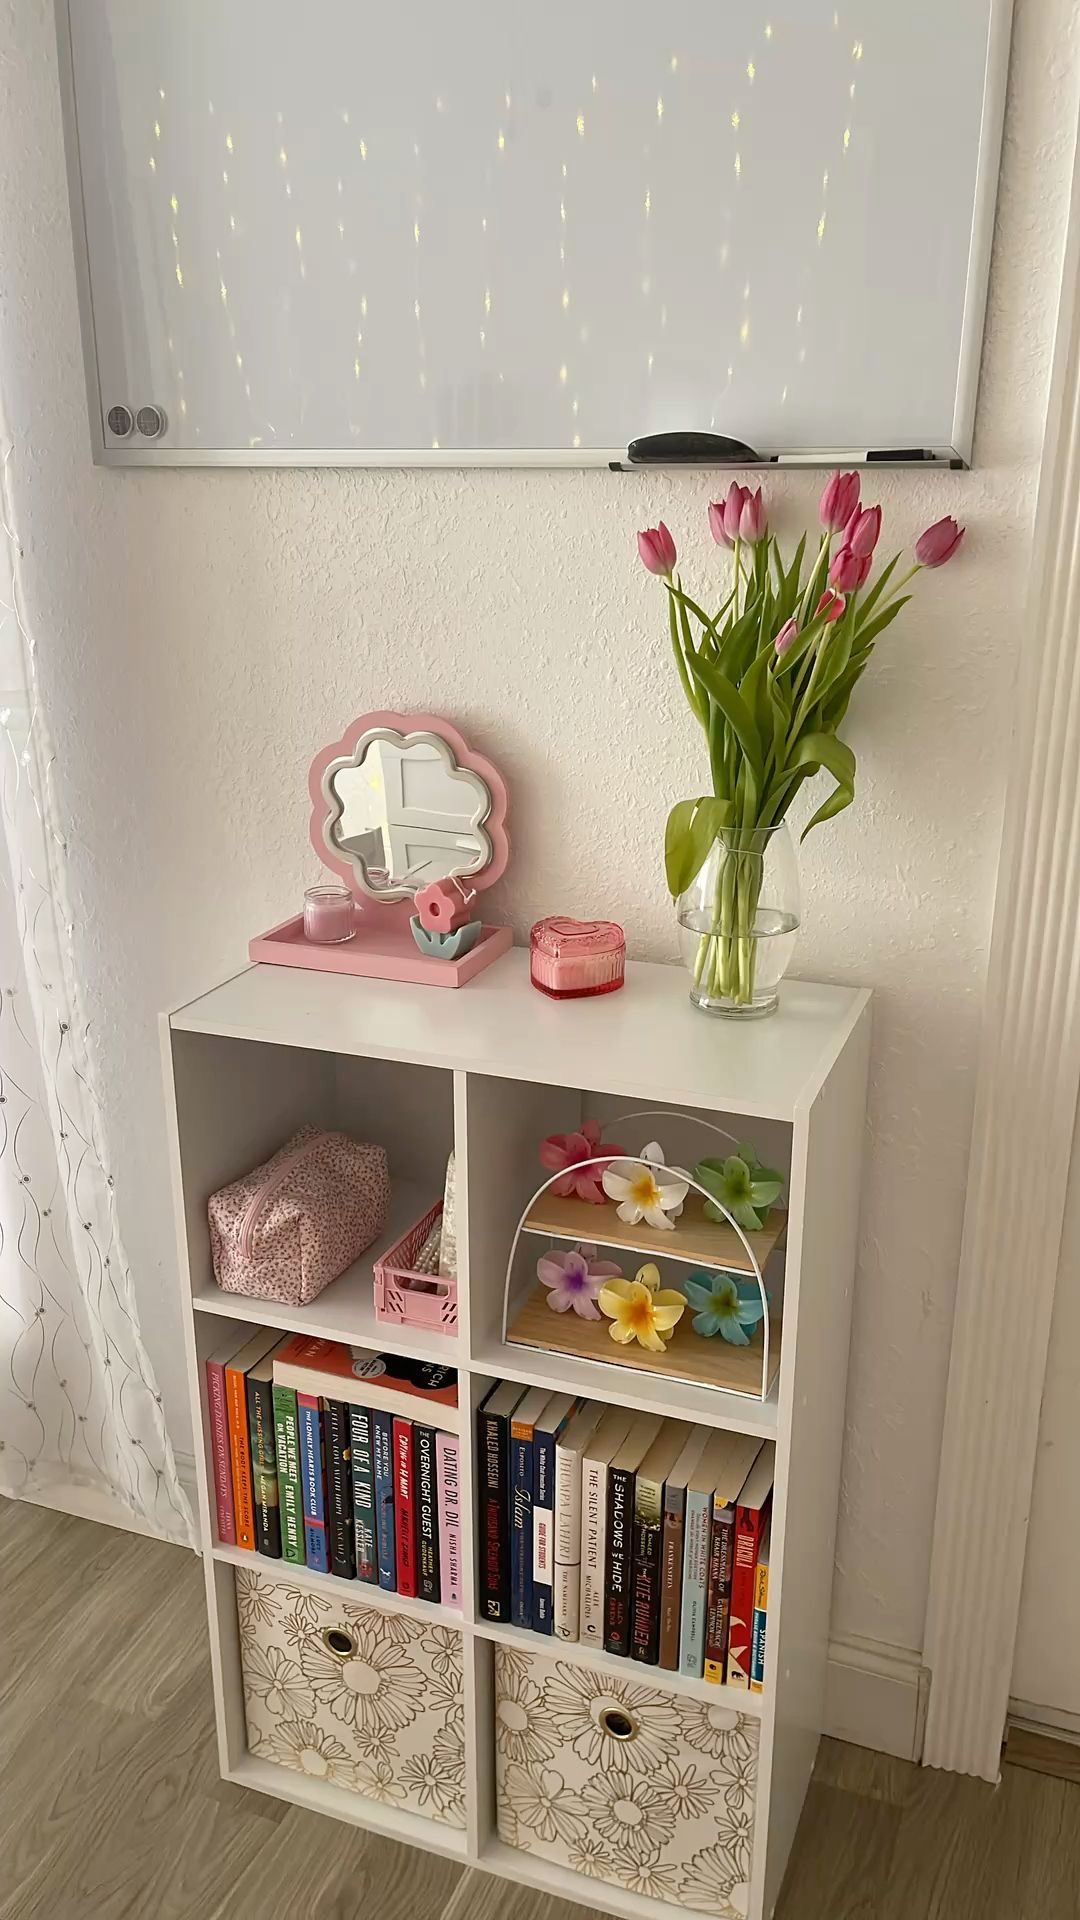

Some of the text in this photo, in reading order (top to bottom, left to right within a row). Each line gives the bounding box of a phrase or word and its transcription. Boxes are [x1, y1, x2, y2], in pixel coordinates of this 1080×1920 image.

[211, 1372, 221, 1409] PICKING
[217, 1445, 224, 1459] ON
[256, 1421, 264, 1449] MISSING
[286, 1415, 297, 1483] PEOPLE WE MEET
[278, 1434, 288, 1474] VACATION
[307, 1450, 315, 1478] HEARTS
[351, 1413, 371, 1508] FOUR OF A KIND
[376, 1447, 382, 1459] MY
[487, 1420, 498, 1489] KHALED HOSSEINI
[219, 1460, 228, 1498] SUNDAYS
[399, 1468, 408, 1478] H
[400, 1478, 408, 1500] MART
[420, 1439, 432, 1540] OVERNIGHT GUEST
[443, 1447, 459, 1527] DATING DR. DIL
[613, 1474, 627, 1482] THE
[285, 1485, 297, 1548] EMILY HENRY
[514, 1484, 531, 1529] Islam
[559, 1455, 572, 1559] JHUMPA LAHIRI
[587, 1470, 598, 1568] THE SILENT PATIENT
[613, 1483, 624, 1548] SHADOWS
[701, 1507, 709, 1529] WOMEN
[355, 1518, 365, 1553] KESSLER
[364, 1527, 373, 1548] KATE
[538, 1522, 546, 1569] GUIDE FOR STUDENTS
[701, 1530, 707, 1538] IN
[736, 1534, 755, 1569] DRACULA
[450, 1558, 458, 1586] SHARMA
[612, 1561, 622, 1592] HIDE
[667, 1541, 675, 1588] FRANKENSTEIN
[698, 1564, 706, 1588] COATS
[711, 1558, 719, 1580] KHANA
[719, 1541, 727, 1582] DRESSMAKER
[636, 1574, 651, 1601] KITE
[719, 1583, 725, 1592] OF
[634, 1600, 651, 1646] RUNNER
[758, 1629, 766, 1665] SPANISH
